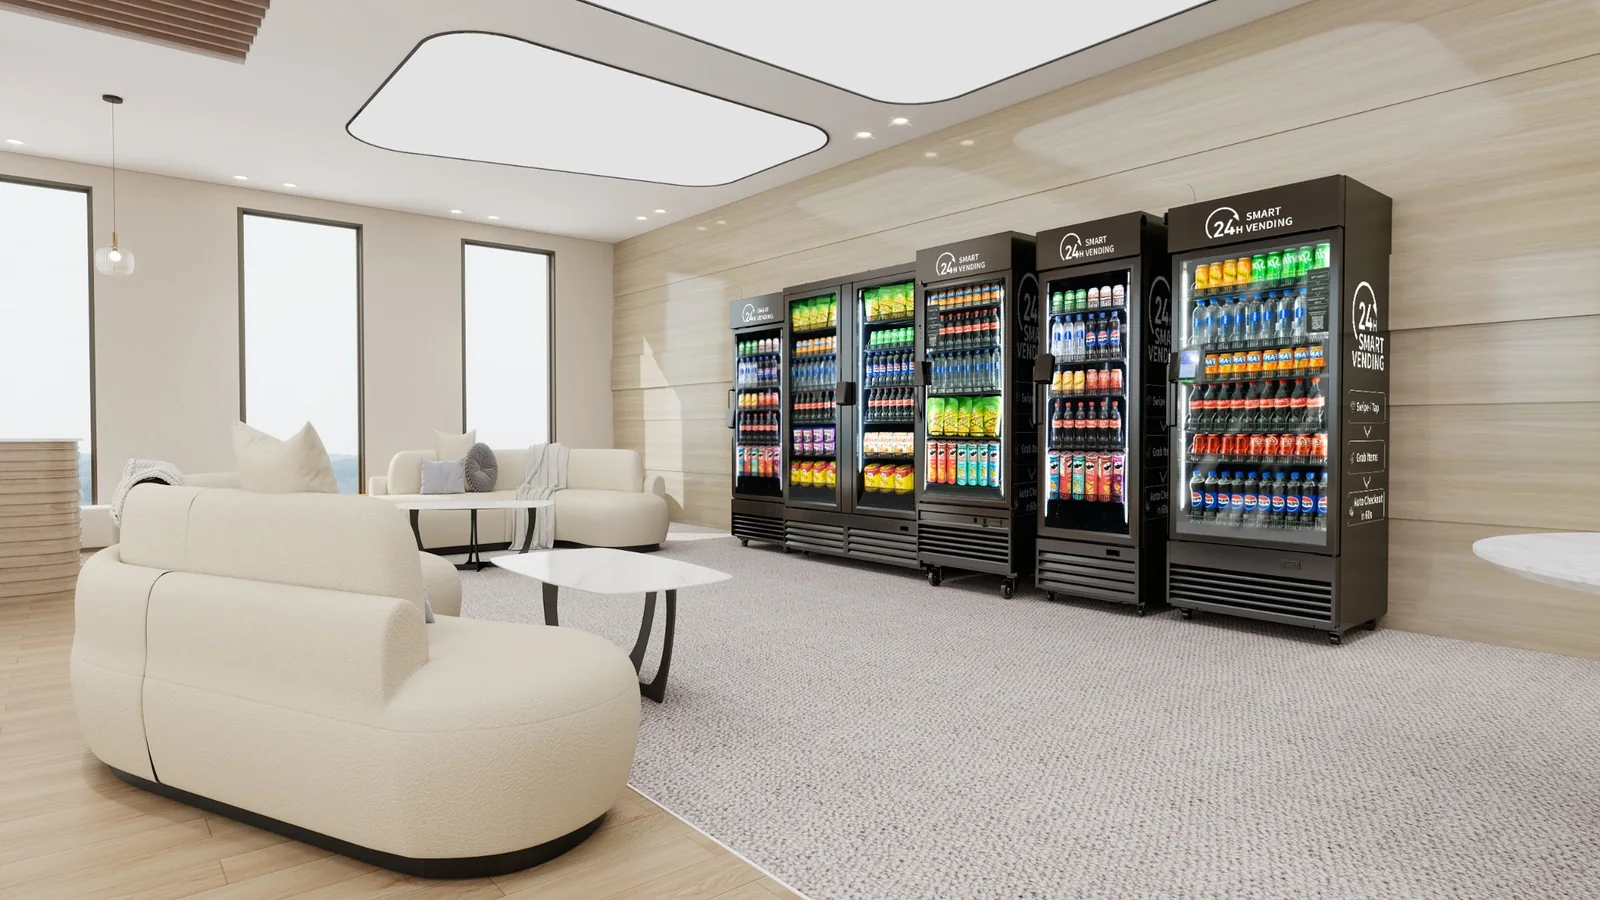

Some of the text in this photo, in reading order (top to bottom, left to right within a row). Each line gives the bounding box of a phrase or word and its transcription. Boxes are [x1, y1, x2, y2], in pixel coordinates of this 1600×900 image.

[1246, 206, 1281, 221] SMART
[1246, 217, 1293, 232] VENDING
[1085, 235, 1107, 246] SMART
[959, 253, 979, 263] SMART
[1085, 245, 1114, 257] VENDING
[959, 261, 985, 272] VENDING
[1155, 296, 1170, 326] 24
[1024, 324, 1039, 343] SMA
[1155, 328, 1170, 347] SMA
[1017, 341, 1038, 360] VEND
[1358, 333, 1384, 354] SMART
[1148, 344, 1169, 364] VEND
[1352, 350, 1384, 371] VENDING
